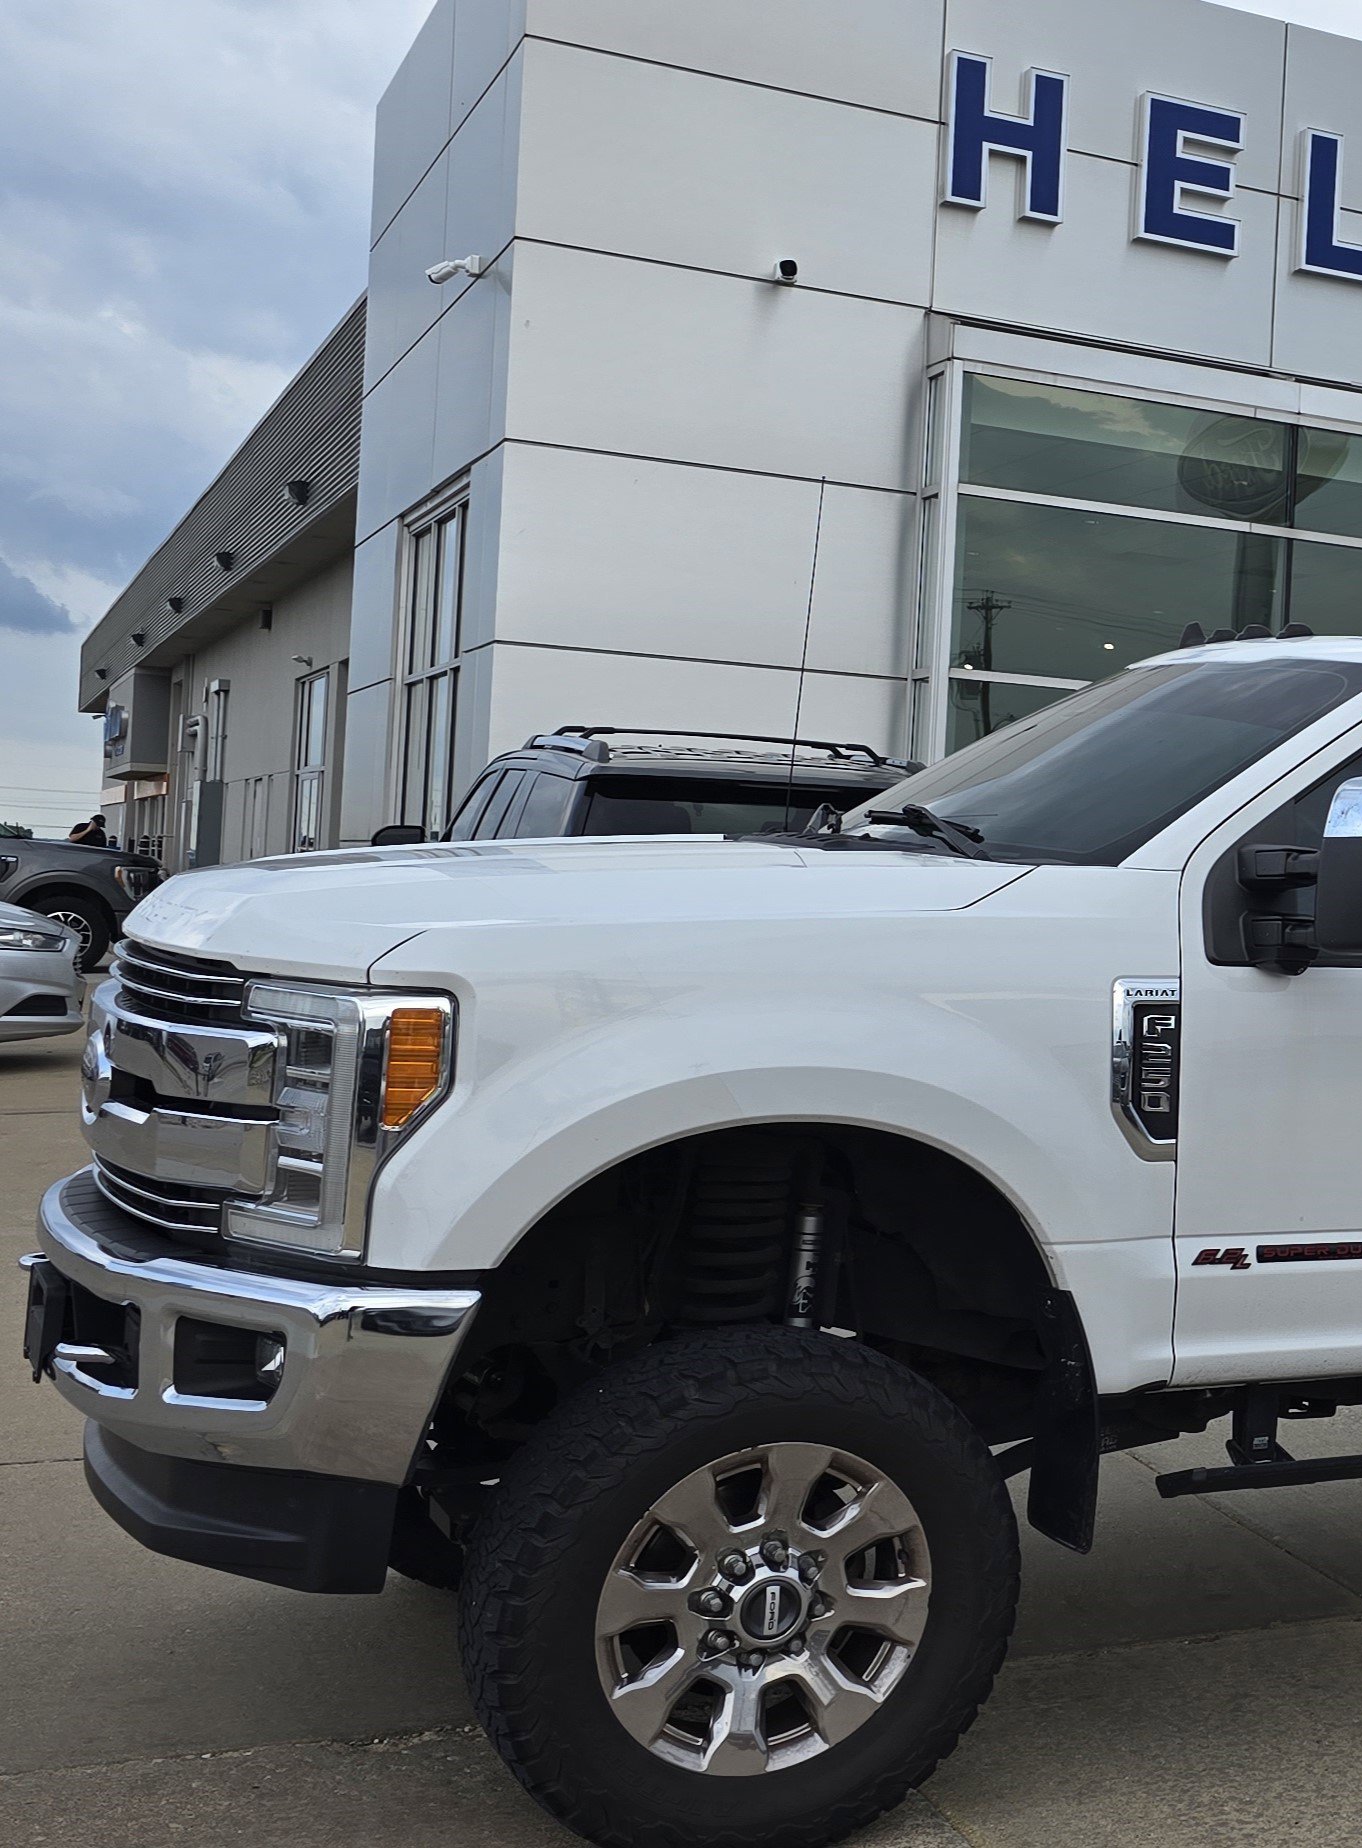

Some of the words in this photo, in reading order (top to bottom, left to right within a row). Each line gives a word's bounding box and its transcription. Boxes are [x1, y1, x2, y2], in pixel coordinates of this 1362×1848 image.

[1126, 989, 1177, 997] LARIAT
[1263, 1245, 1329, 1258] SUPER
[768, 1591, 776, 1631] FORD
